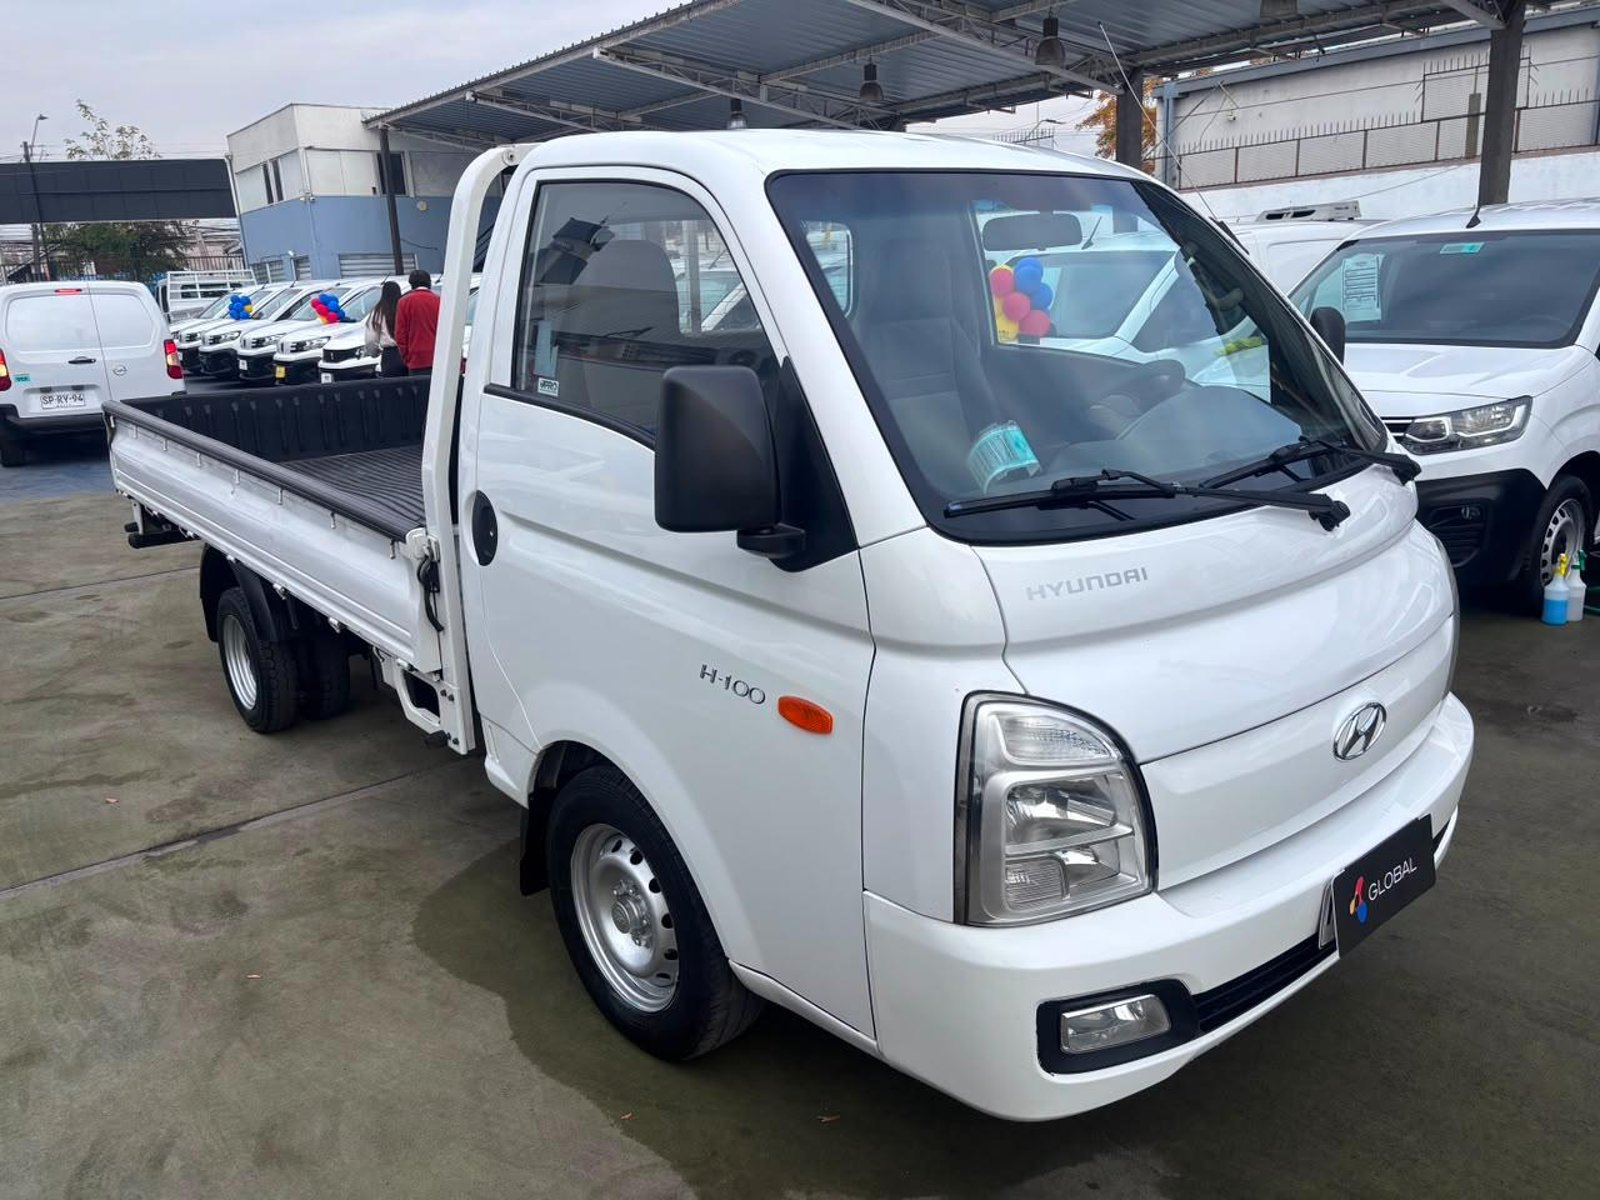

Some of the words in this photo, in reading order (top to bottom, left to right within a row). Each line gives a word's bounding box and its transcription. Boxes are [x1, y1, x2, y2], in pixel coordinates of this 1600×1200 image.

[1025, 566, 1148, 601] HYUNDAI
[699, 663, 766, 705] H-100
[1367, 857, 1418, 901] GLOBAL
